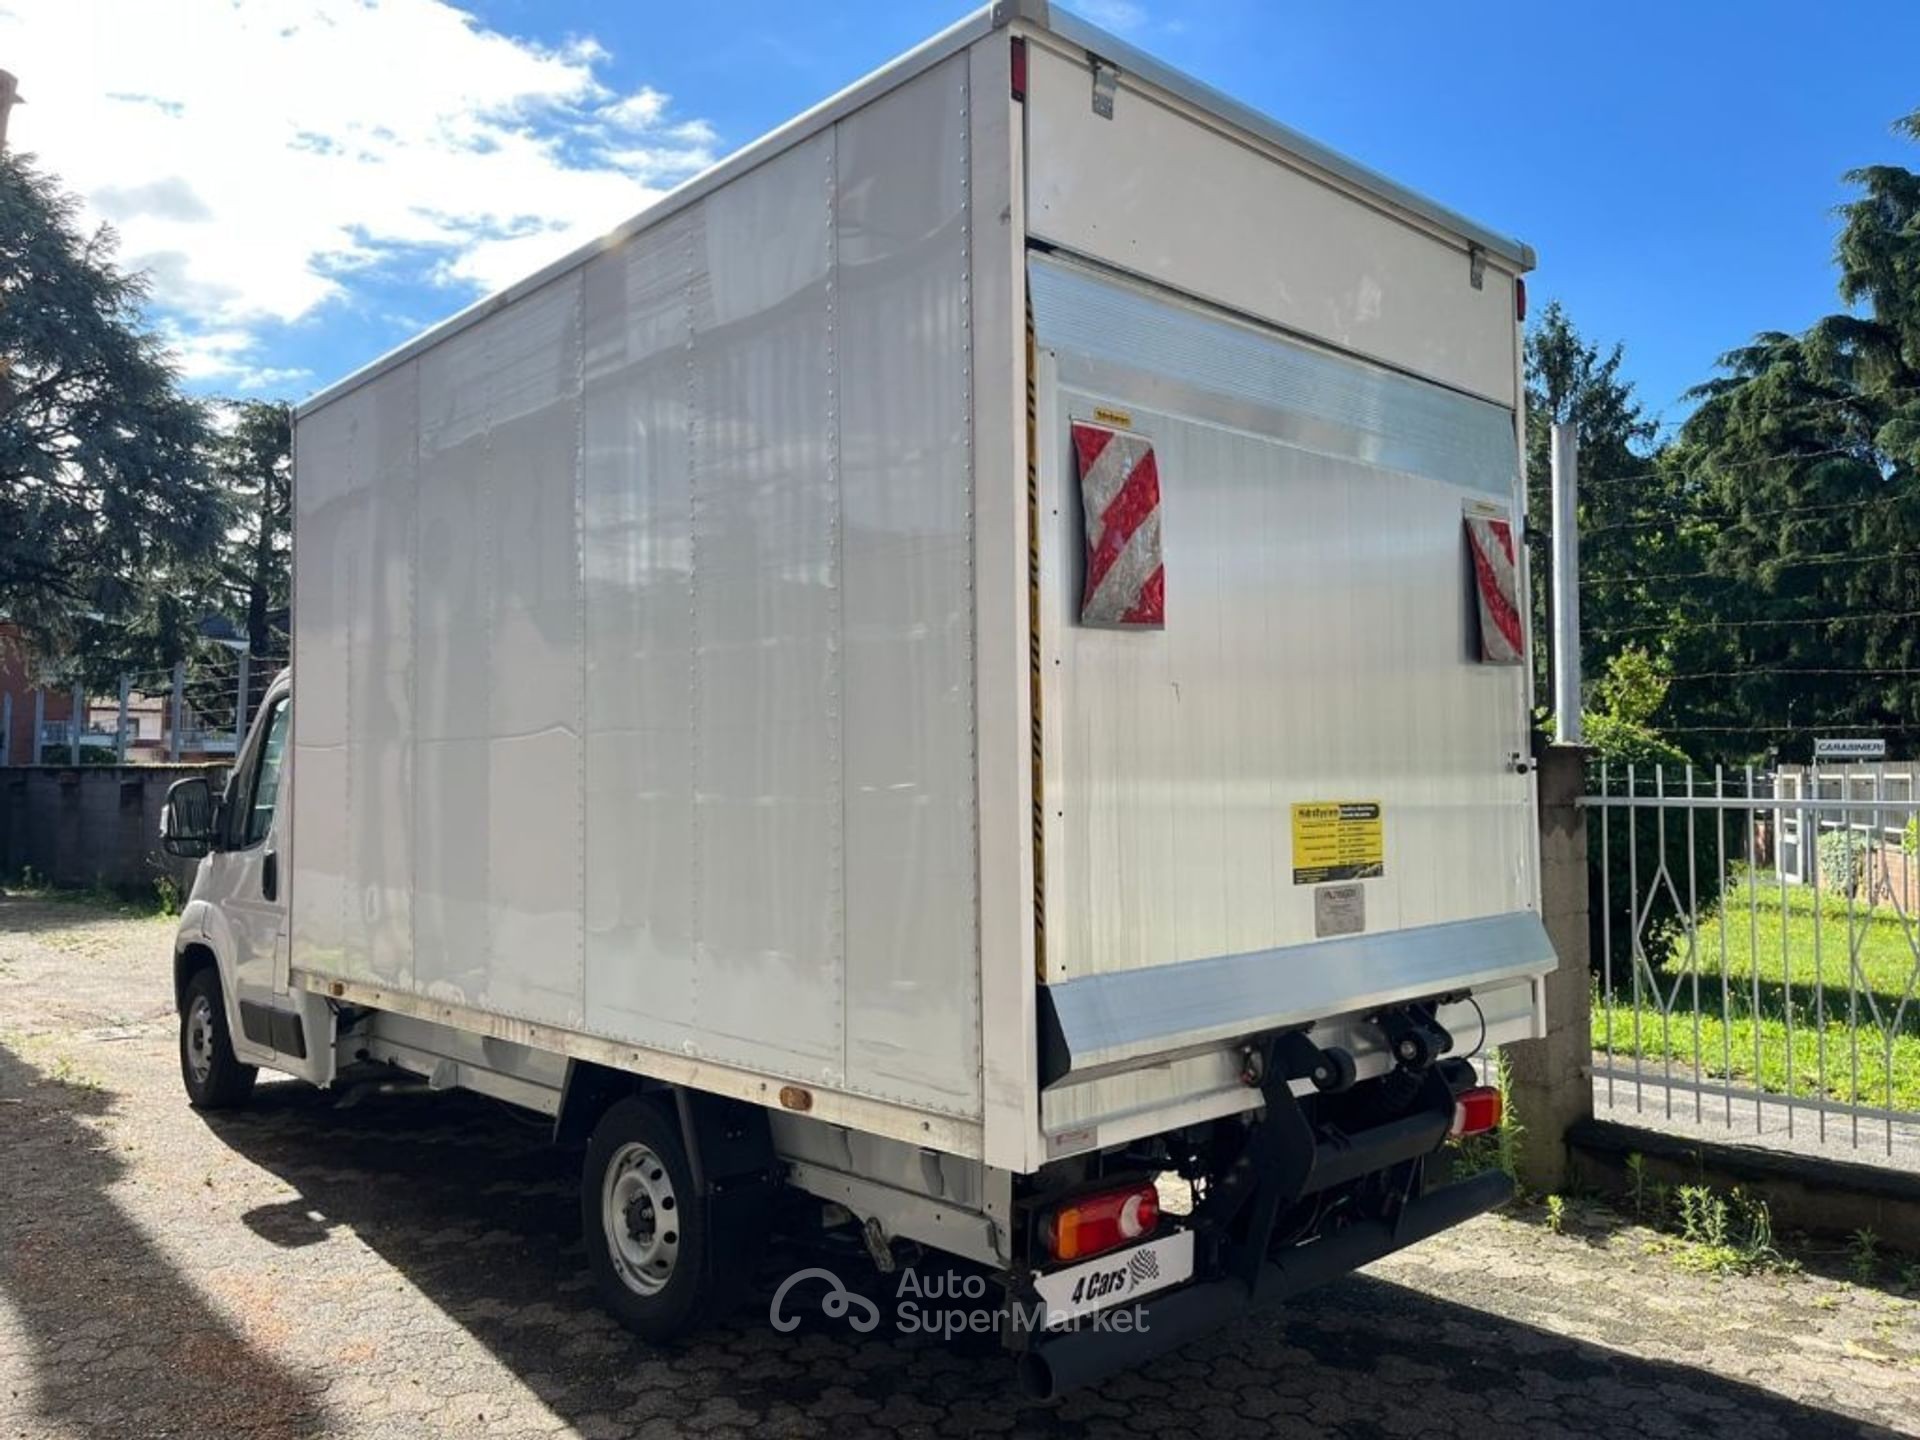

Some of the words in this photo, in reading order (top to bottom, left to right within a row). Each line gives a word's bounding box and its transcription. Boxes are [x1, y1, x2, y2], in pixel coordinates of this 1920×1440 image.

[1818, 742, 1884, 752] CARABINIERI
[1071, 1276, 1086, 1305] 4
[1086, 1267, 1129, 1301] Cars
